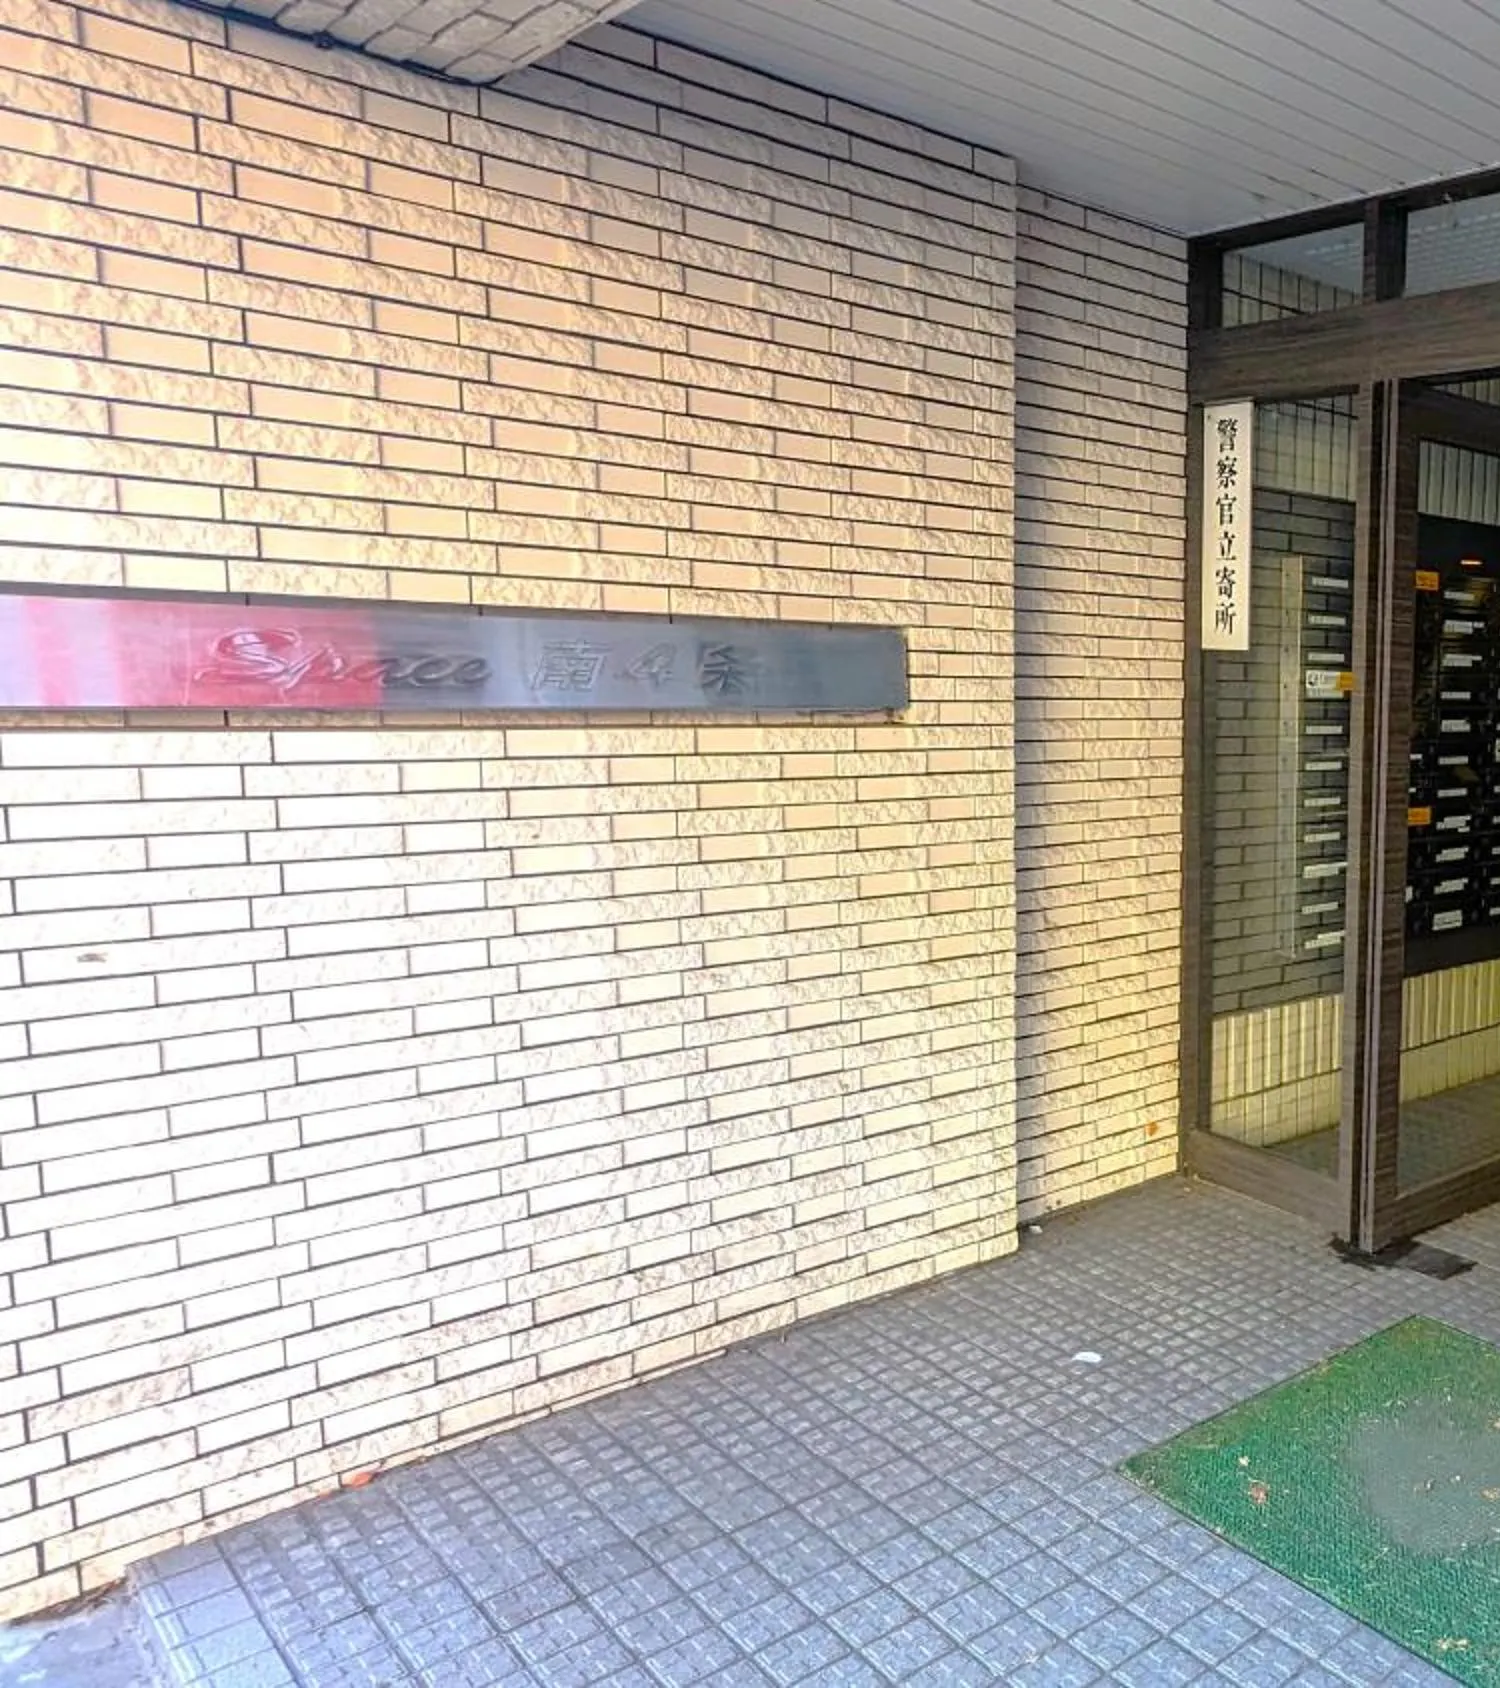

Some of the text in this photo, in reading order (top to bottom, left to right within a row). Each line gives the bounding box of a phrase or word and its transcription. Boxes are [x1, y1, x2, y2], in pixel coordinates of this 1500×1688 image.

[1214, 418, 1239, 636] 警察官立寄所
[194, 626, 491, 690] Space
